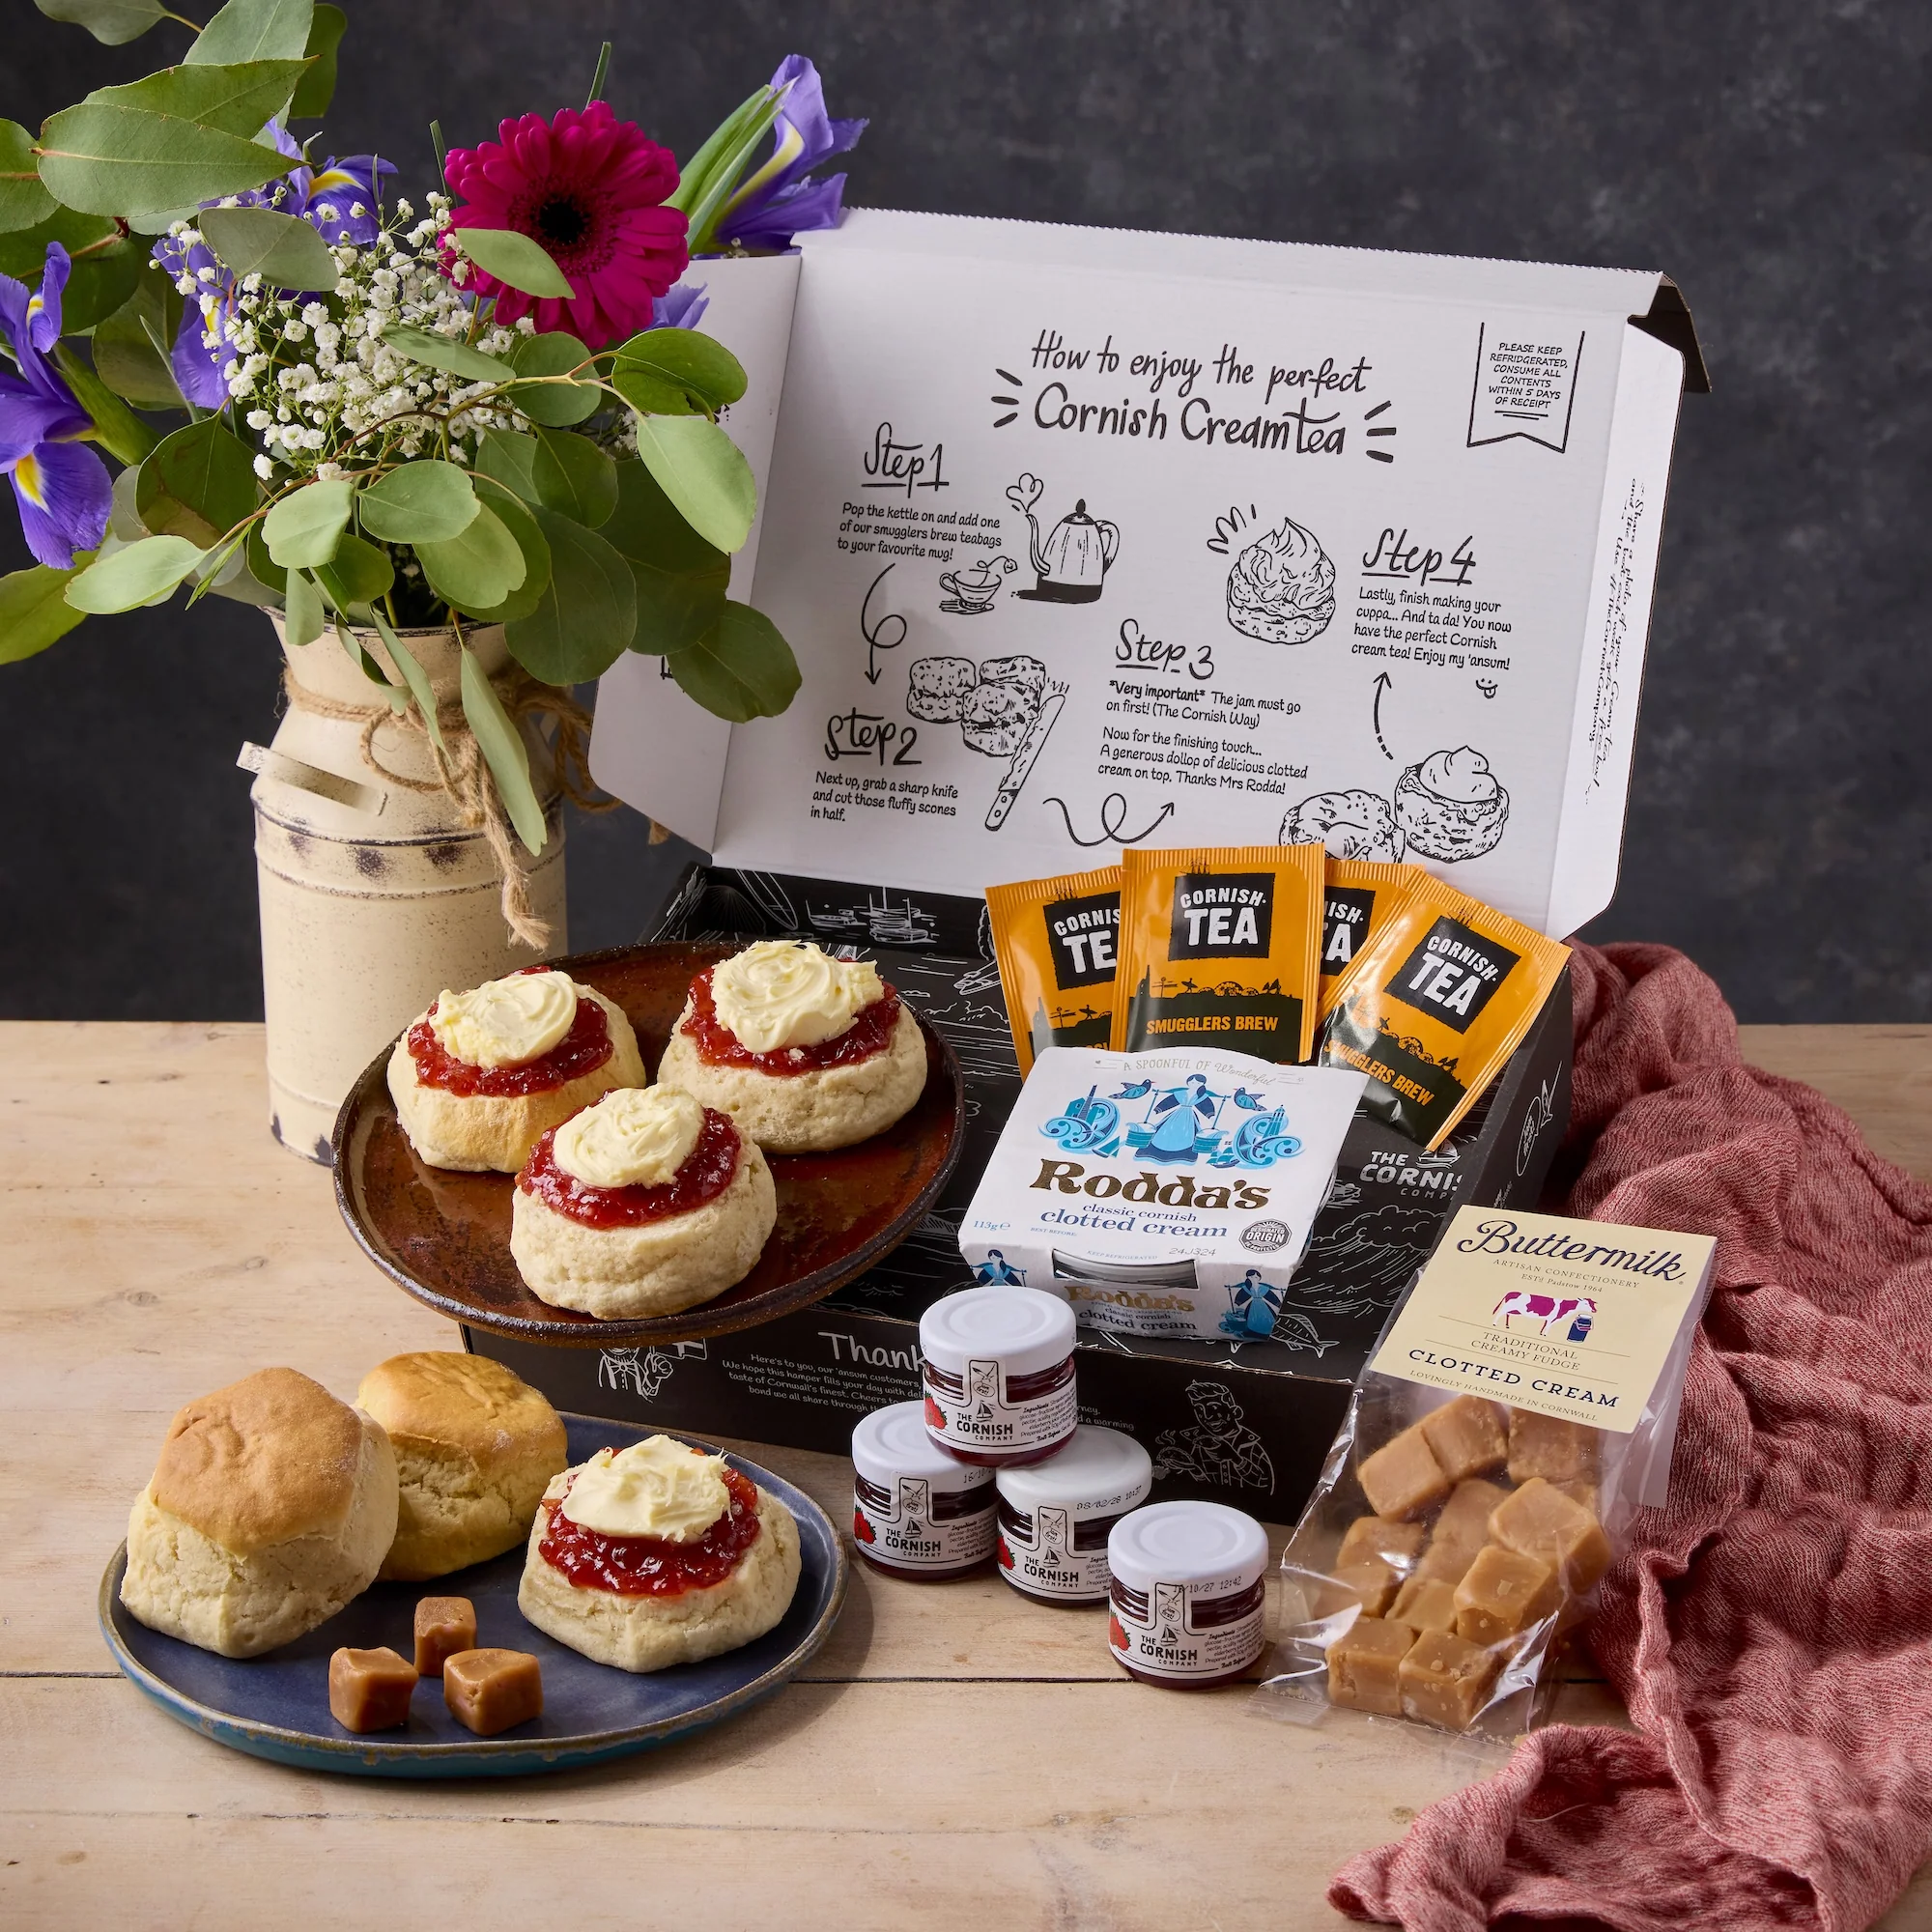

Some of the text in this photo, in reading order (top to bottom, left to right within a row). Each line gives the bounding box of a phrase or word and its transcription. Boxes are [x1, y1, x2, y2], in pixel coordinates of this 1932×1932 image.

[1498, 343, 1563, 355] PLEASE KEEP
[1032, 329, 1372, 404] How to enjoy the perfect
[1492, 365, 1541, 375] CONSUME
[1489, 386, 1523, 395] WITHIN
[1535, 390, 1562, 399] DAYS
[1500, 376, 1552, 387] CONTENTS
[1035, 382, 1167, 440] Cornish
[1510, 398, 1551, 408] RECEIPT
[864, 421, 943, 498] Step 1
[842, 502, 1001, 528] Pop the kettle on and add one
[839, 520, 1002, 549] of our smugglers brew teabags
[837, 537, 953, 562] to your favourite mug!
[1362, 527, 1476, 586] Step 4
[1359, 587, 1502, 614] Lastly, finish making your
[1400, 610, 1427, 623] And
[1428, 612, 1440, 624] ta
[1442, 612, 1460, 627] da!
[1462, 615, 1485, 629] You
[1487, 622, 1512, 632] now
[1116, 618, 1214, 680] Step 3
[1353, 623, 1498, 649] have the perfect Cornish
[1351, 644, 1511, 670] cream tea! Enjoy my 'ansum!
[1106, 699, 1261, 729] on first! (The Cornish Way)
[1210, 692, 1234, 705] The
[1233, 695, 1256, 709] jam
[1257, 699, 1285, 711] must
[1286, 703, 1301, 715] go
[824, 706, 923, 766] Step 2
[815, 771, 959, 798] Next up, grab a sharp knife
[810, 806, 846, 821] in half.
[812, 789, 956, 815] and cut those fluffy scones
[1053, 908, 1121, 937] CORNIS
[1183, 907, 1259, 946] TEA
[1063, 930, 1117, 974] TE
[1407, 952, 1483, 1016] TEA
[1146, 1016, 1279, 1035] SMUGGLERS BREW
[1123, 1059, 1278, 1086] A SPOONFUL OF Wonderful
[1323, 1038, 1435, 1107] SMUGGLERS BREW
[1371, 1151, 1409, 1166] THE
[1030, 1158, 1271, 1209] Rodda's
[1040, 1209, 1228, 1237] clotted cream
[1083, 1204, 1197, 1222] classic cornish
[1246, 1232, 1285, 1243] ORIGIN
[1456, 1219, 1688, 1281] Buttermilk
[1493, 1259, 1639, 1289] ARTISAN CONFECTIONERY
[1548, 1279, 1579, 1289] Padstow
[1471, 1340, 1580, 1371] CREAMY FUDGE
[1483, 1332, 1578, 1360] TRADITIONAL
[751, 1353, 783, 1366] Here's
[784, 1358, 795, 1369] to
[796, 1363, 815, 1373] you,
[836, 1367, 868, 1379] 'ansum
[869, 1374, 922, 1389] customers,
[1409, 1350, 1620, 1408] CLOTTED CREAM
[1409, 1370, 1598, 1422] LOVINGLY HANDMADE IN CORNWALL
[956, 1421, 1013, 1435] CORNISH
[957, 1413, 972, 1422] THE
[886, 1536, 941, 1551] CORNISH
[887, 1528, 901, 1538] THE
[1024, 1564, 1079, 1582] CORNISH
[1025, 1556, 1039, 1566] THE
[1041, 1579, 1079, 1588] COMPANY
[1140, 1642, 1198, 1661] CORNISH
[1141, 1634, 1156, 1645] THE
